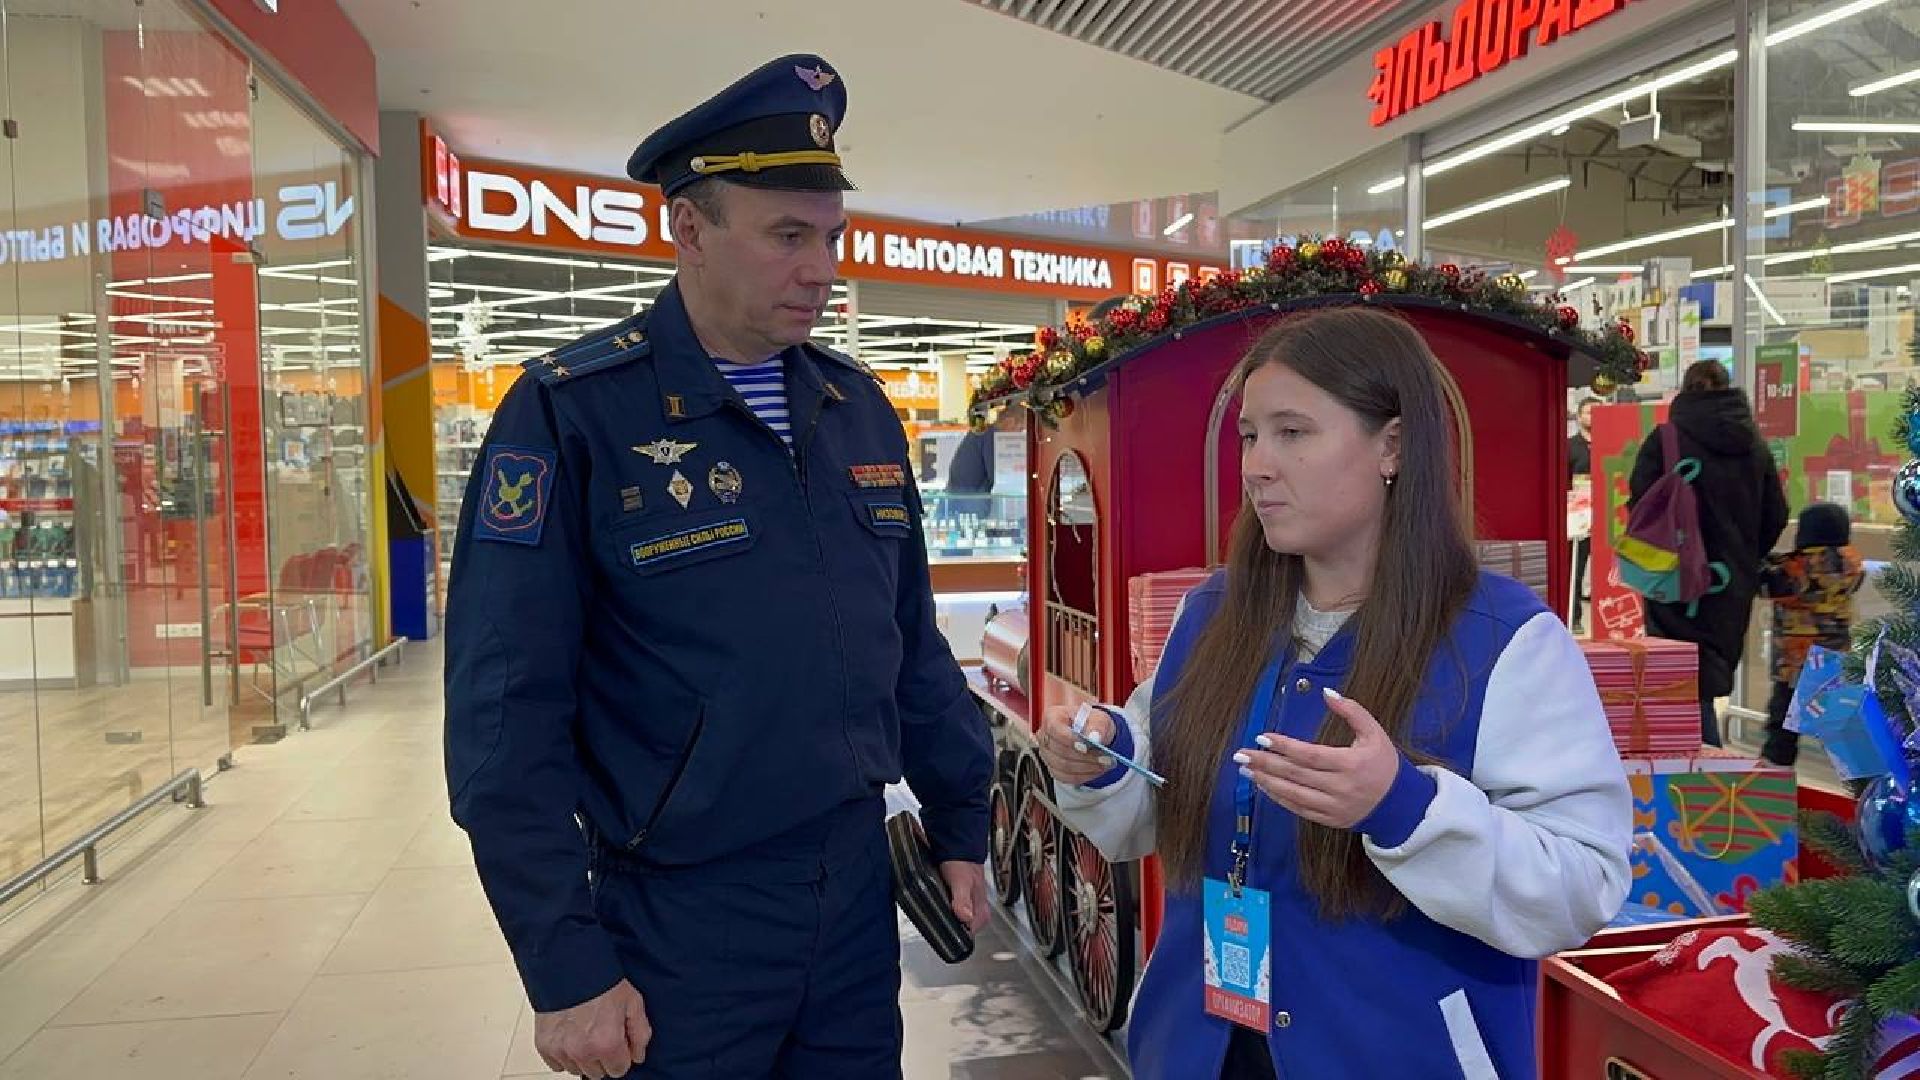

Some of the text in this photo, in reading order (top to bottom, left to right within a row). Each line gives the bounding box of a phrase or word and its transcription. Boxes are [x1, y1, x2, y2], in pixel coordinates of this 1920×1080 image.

[467, 171, 648, 246] DNS
[853, 231, 875, 265] И
[884, 234, 1004, 279] БЫТОВАЯ
[1011, 249, 1113, 290] ТЕХНИКА
[690, 528, 715, 545] СИЛЫ
[715, 522, 745, 539] РОССИИ
